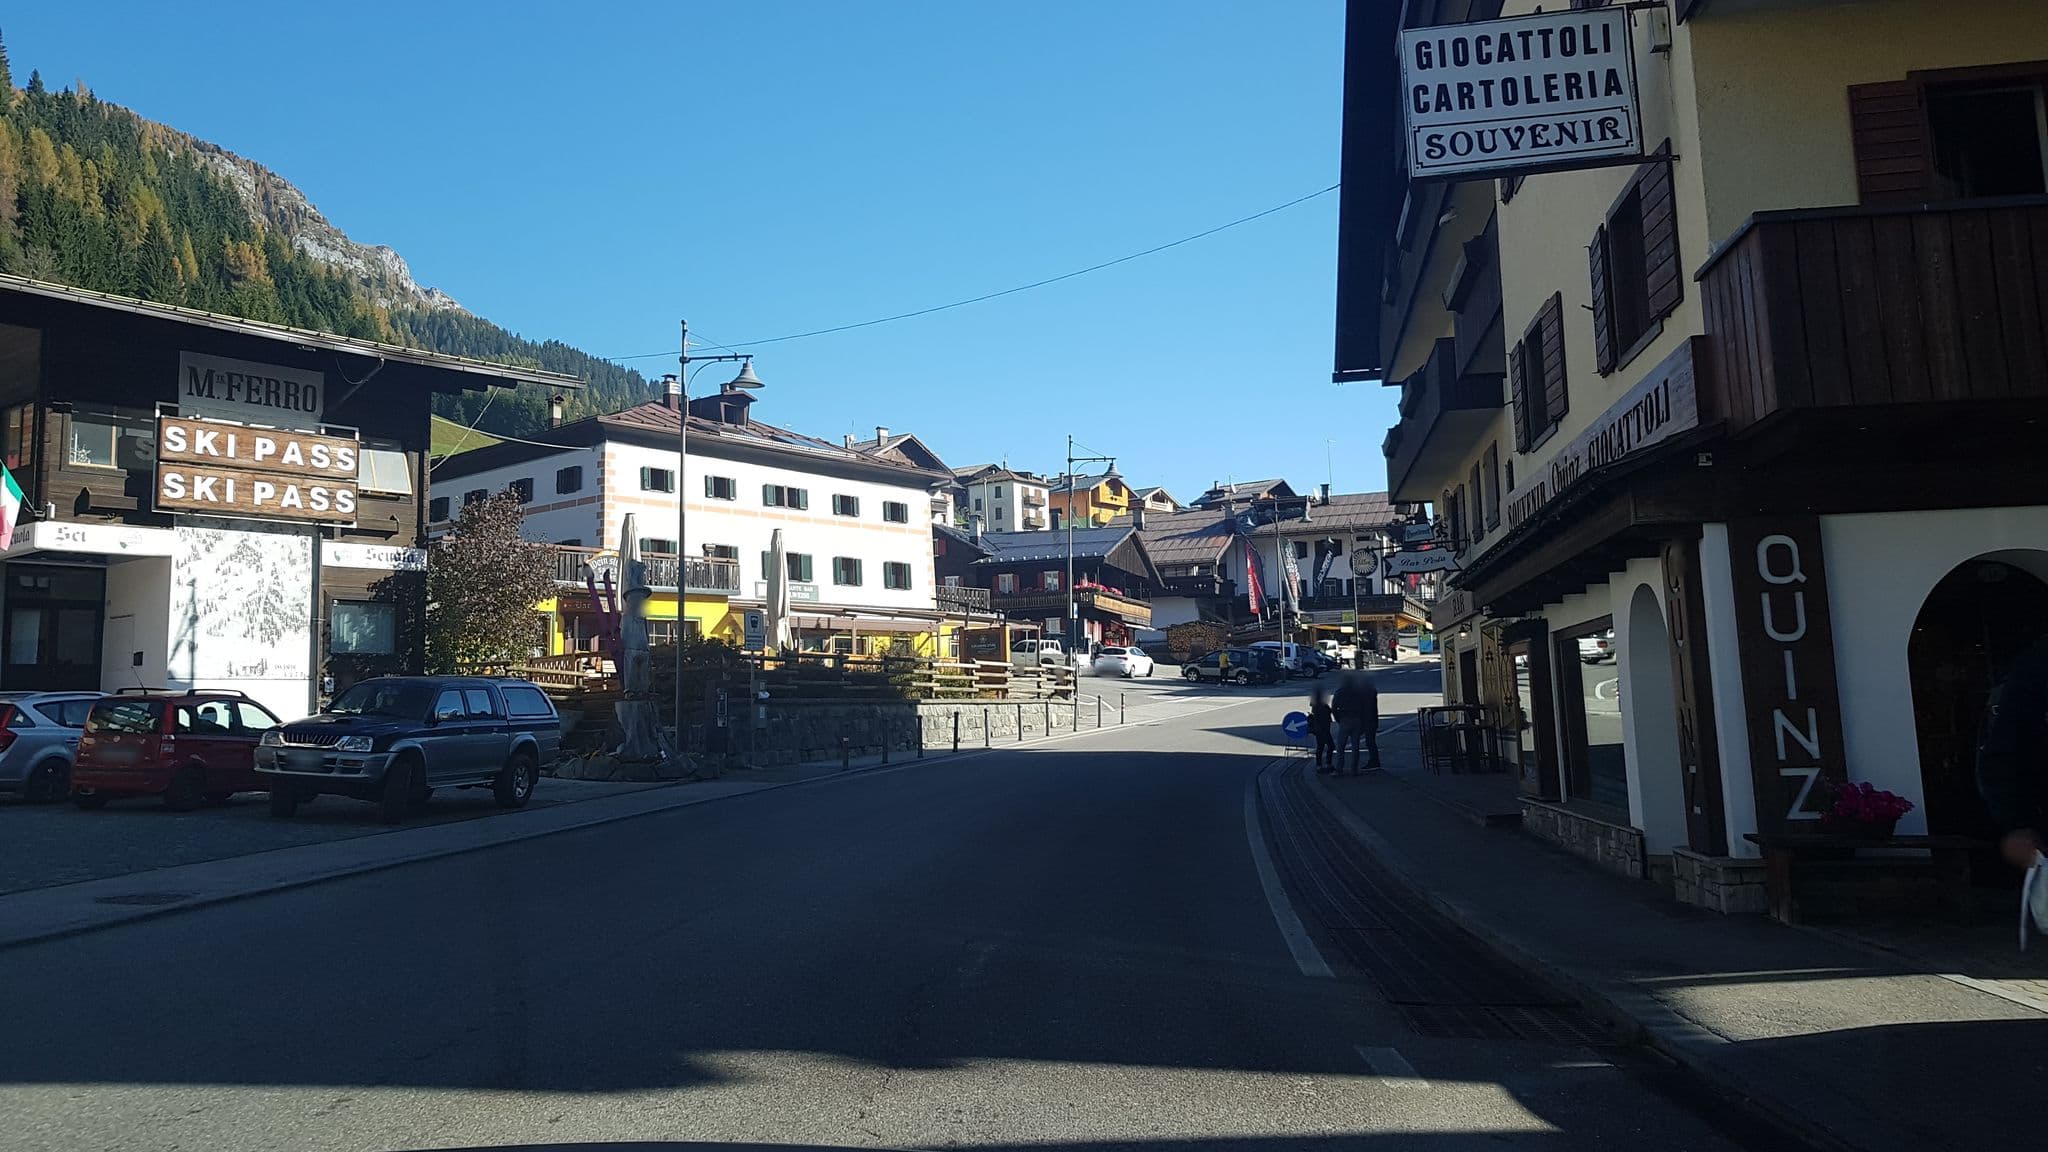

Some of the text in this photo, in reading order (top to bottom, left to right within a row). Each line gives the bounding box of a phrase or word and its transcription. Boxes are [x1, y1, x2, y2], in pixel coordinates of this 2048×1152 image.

[1415, 23, 1612, 70] GIOCATTOLI
[1413, 68, 1623, 114] CARTOLERIA
[1425, 116, 1622, 159] SOUVENIR
[226, 371, 317, 413] FERRO
[164, 426, 235, 458] SKI
[254, 436, 356, 471] PASS
[1508, 378, 1671, 532] SOUVENIR Quinz GIOCATTOLI
[163, 472, 355, 514] SKI PASS
[1452, 592, 1465, 617] BAR
[1756, 534, 1823, 820] QUINZ
